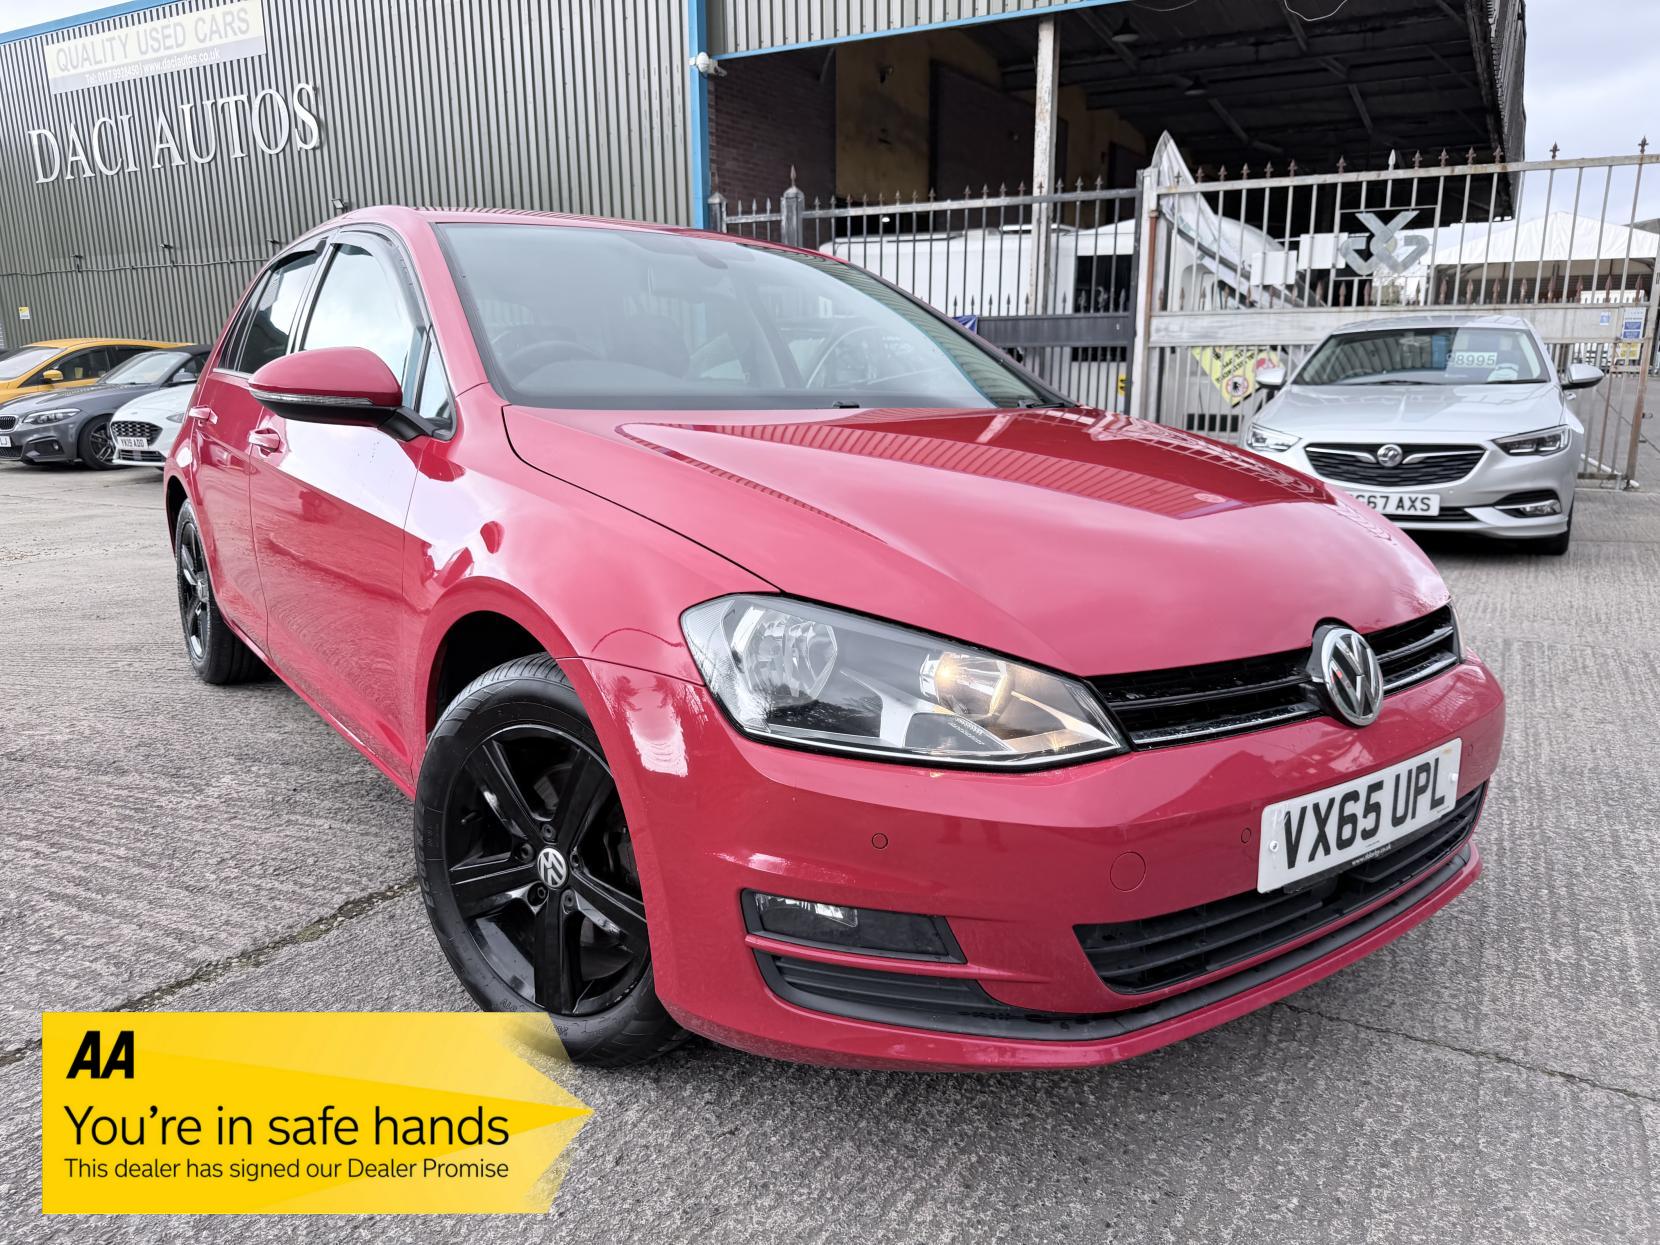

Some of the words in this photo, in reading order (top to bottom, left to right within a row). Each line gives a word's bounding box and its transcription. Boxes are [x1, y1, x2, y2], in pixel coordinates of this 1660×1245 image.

[56, 33, 129, 72] QUALITY
[136, 22, 187, 56] USED
[194, 7, 250, 43] CARS
[28, 112, 140, 184] DACI
[152, 81, 321, 169] AUTOS
[1395, 496, 1432, 512] AXS
[1284, 778, 1384, 869] VX65
[1391, 757, 1446, 828] UPL
